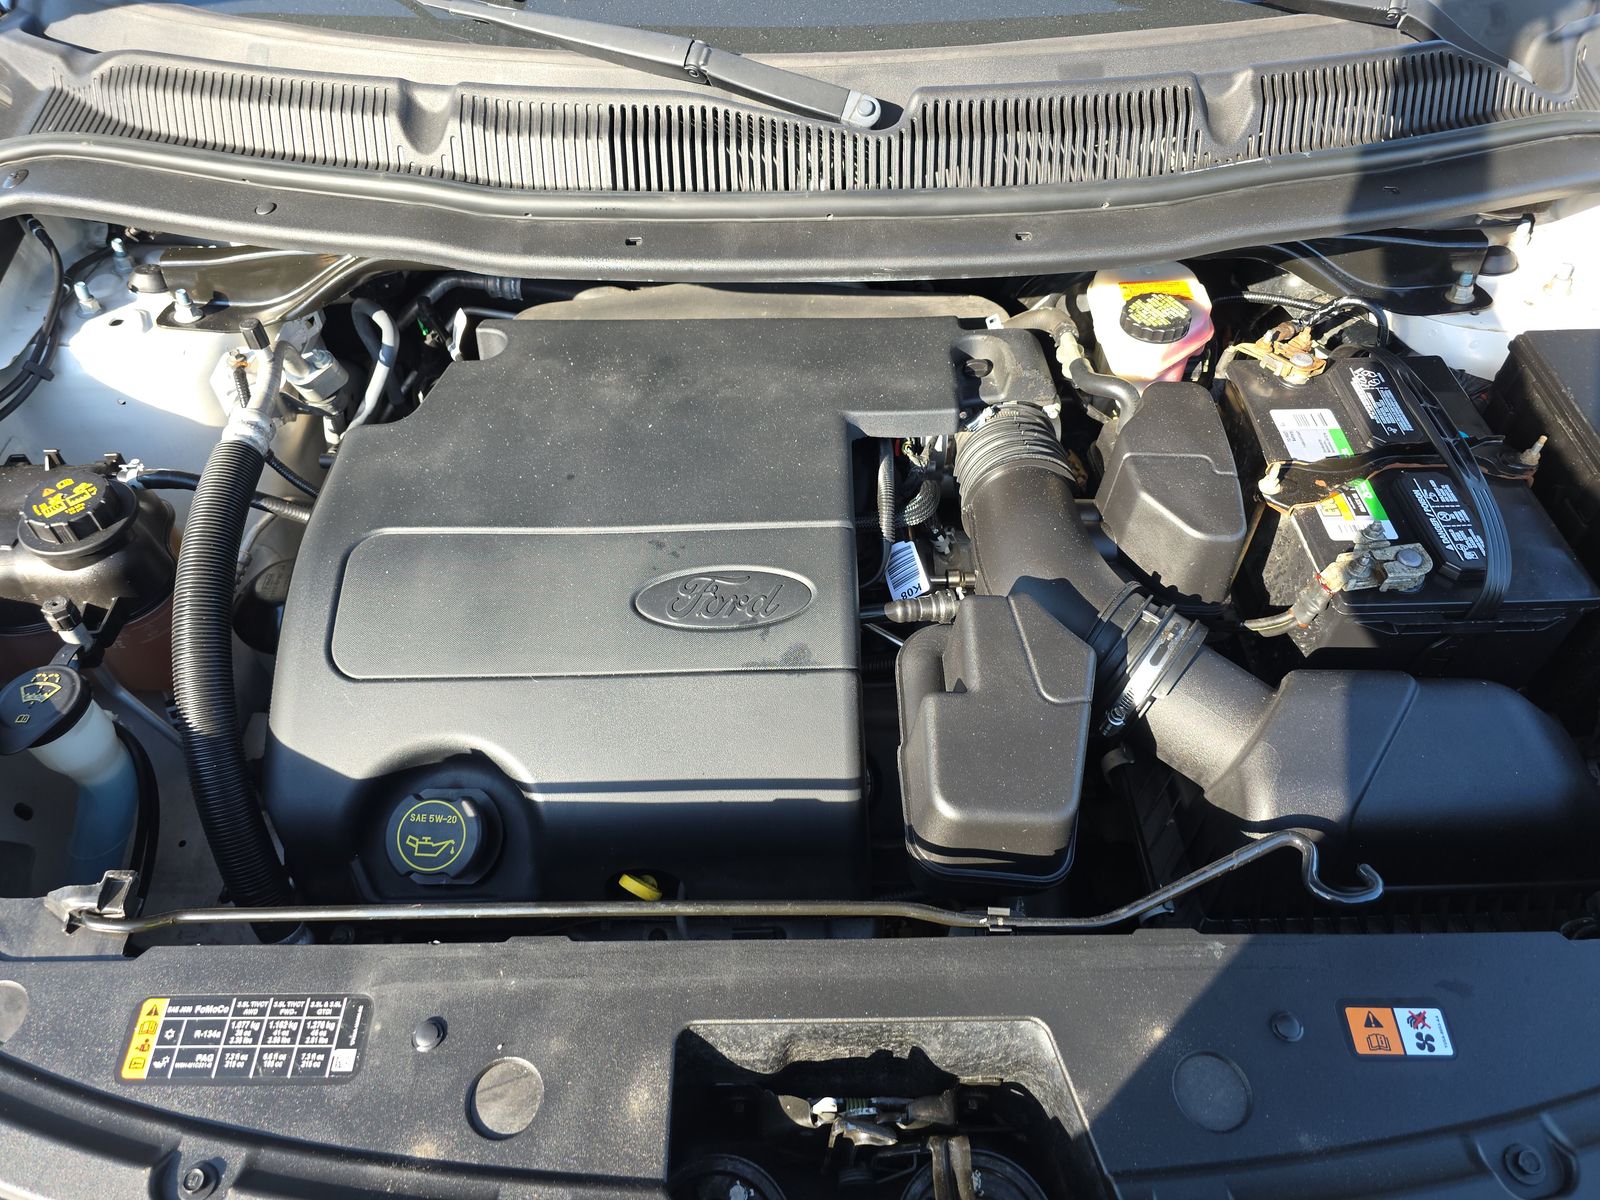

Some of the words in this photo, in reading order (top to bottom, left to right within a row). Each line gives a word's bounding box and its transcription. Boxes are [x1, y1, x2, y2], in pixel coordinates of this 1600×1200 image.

[900, 582, 922, 600] K08
[666, 575, 785, 620] Ford
[410, 813, 427, 823] SAE
[428, 814, 458, 824] 5W-20
[194, 1004, 230, 1015] FoMoCo
[250, 1021, 261, 1031] kg
[288, 1021, 299, 1031] kg
[325, 1021, 336, 1031] kg
[193, 1029, 222, 1039] R-134a
